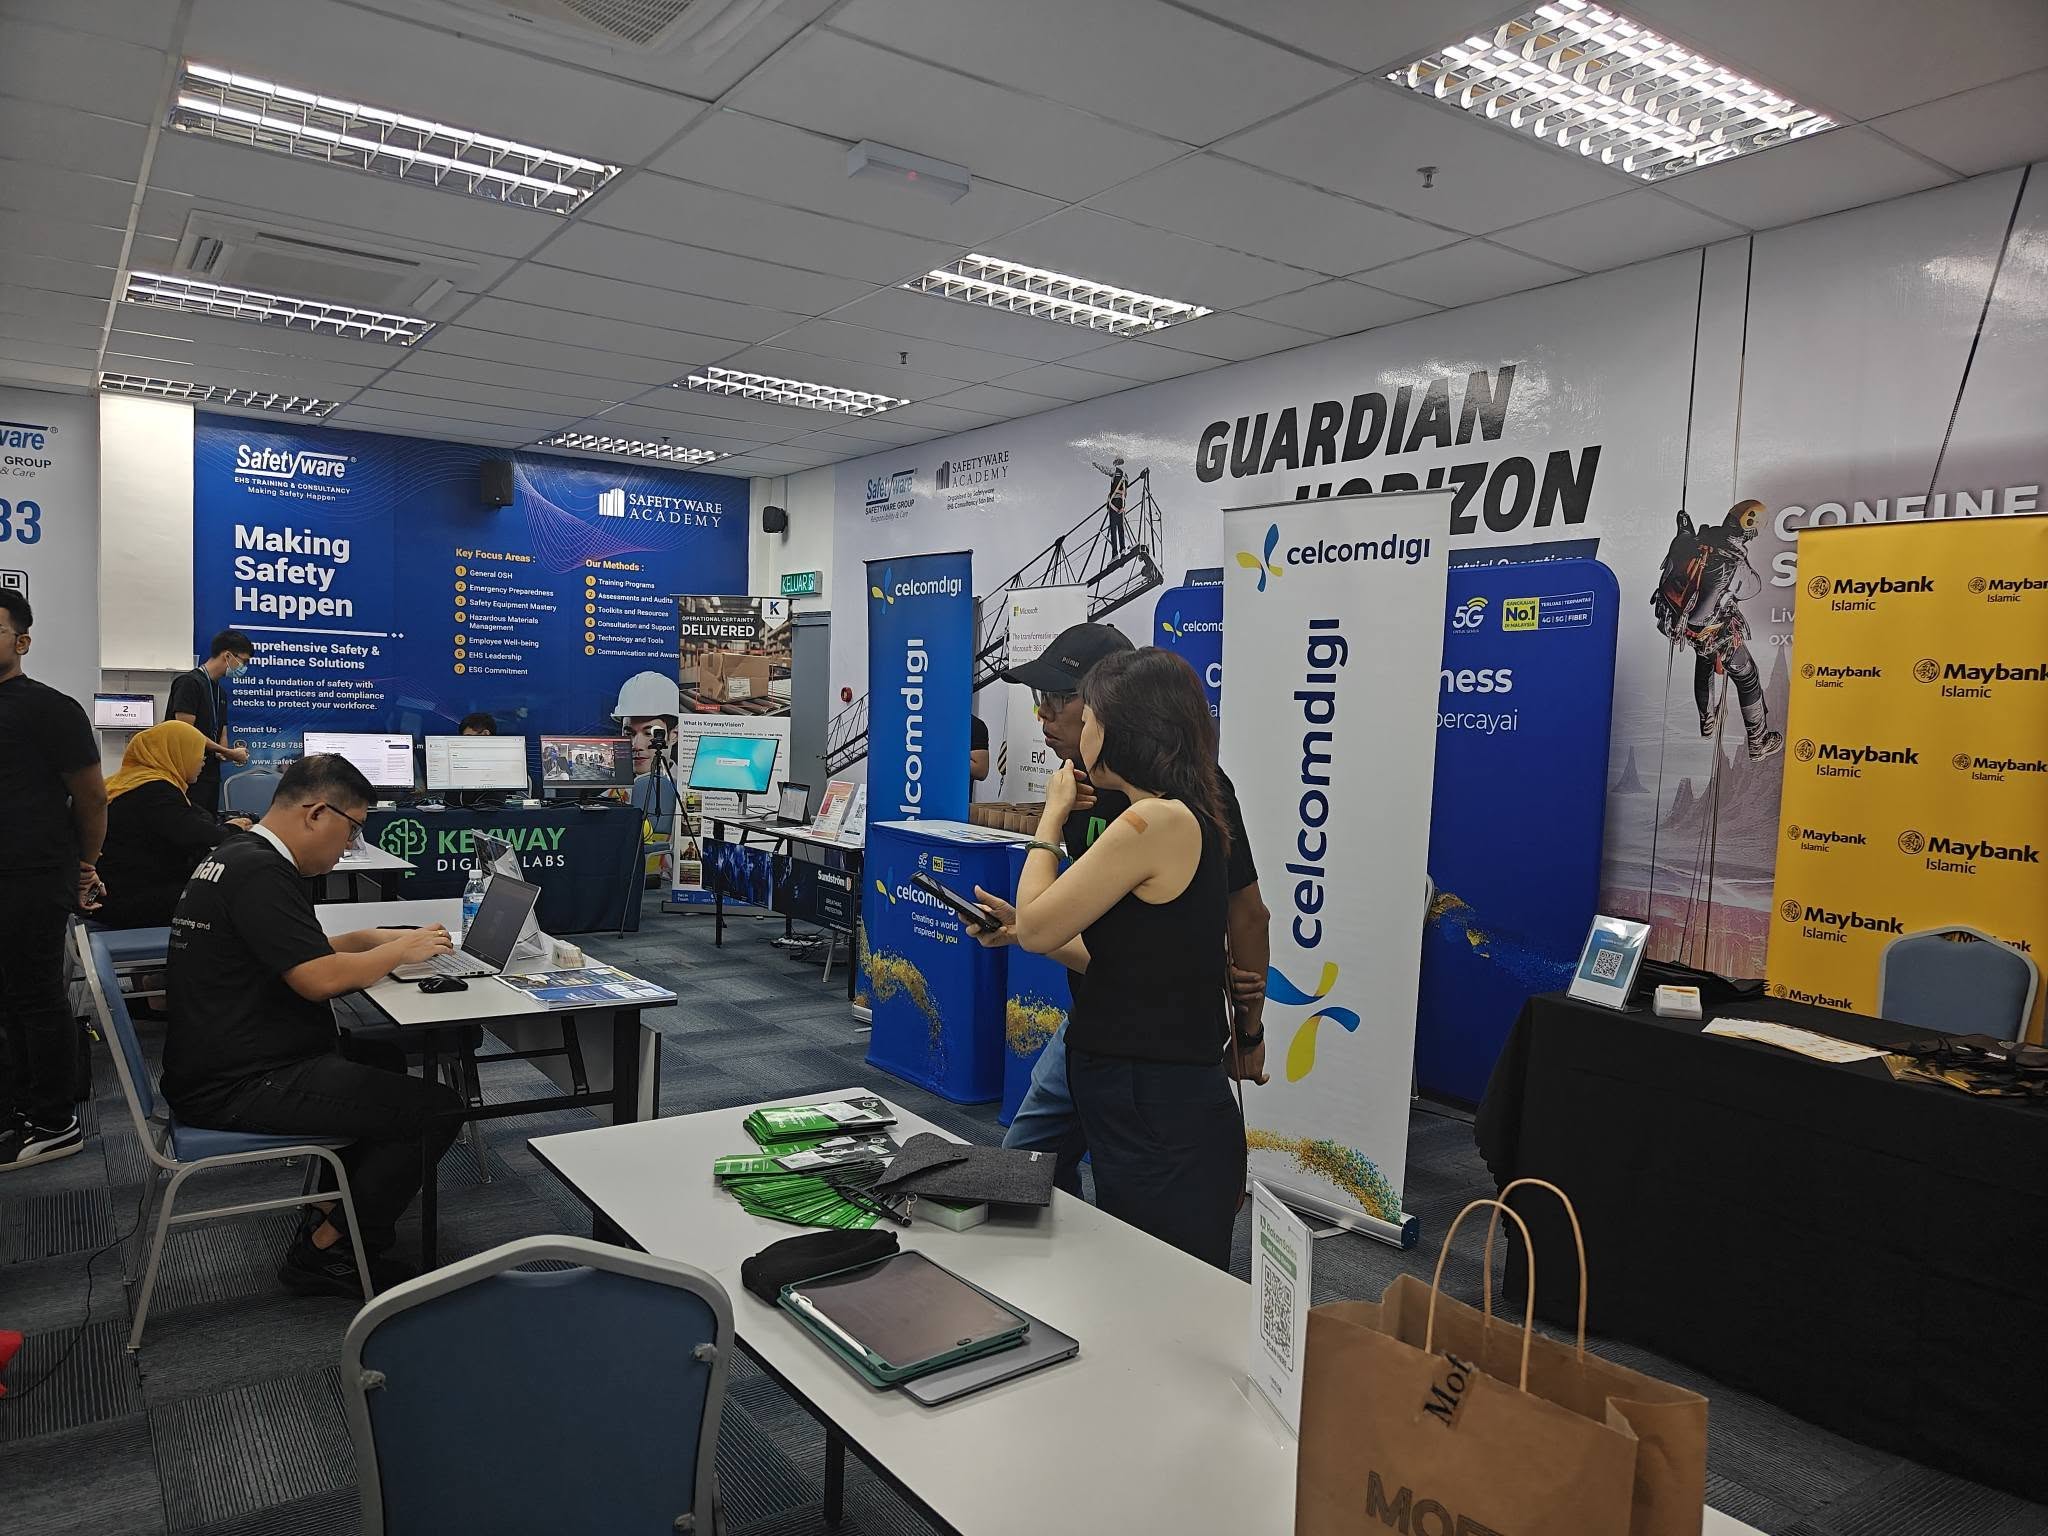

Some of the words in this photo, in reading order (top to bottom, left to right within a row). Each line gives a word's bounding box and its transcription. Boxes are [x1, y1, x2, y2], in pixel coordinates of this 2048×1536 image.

[1195, 365, 1517, 484] GUARDIAN
[4, 455, 52, 469] GROUP
[235, 444, 350, 479] Safetyware
[952, 450, 1009, 474] SAFETYWARE
[12, 467, 36, 478] Care
[952, 465, 1009, 489] ACADEMY
[248, 486, 277, 497] Making
[279, 489, 304, 500] Safety
[306, 492, 336, 502] Happen
[252, 478, 289, 488] TRAINING
[297, 483, 351, 495] CONSULTANCY
[629, 493, 723, 515] SAFETYWARE
[629, 508, 721, 528] ACADEMY
[235, 524, 350, 564] Making
[1286, 533, 1431, 568] celcomdigi
[455, 548, 474, 559] Key
[475, 550, 503, 561] Focus
[505, 552, 531, 563] Areas
[585, 559, 601, 568] Our
[603, 560, 640, 571] Methods
[234, 556, 336, 592] Safety
[469, 569, 496, 579] General
[497, 571, 513, 579] OSH
[598, 578, 624, 588] Training
[624, 580, 655, 589] Programs
[782, 573, 808, 592] KELUAR
[895, 575, 962, 598] celcomdigi
[1832, 575, 1935, 598] Maybank
[469, 584, 508, 595] Emergency
[508, 587, 554, 597] Preparedness
[598, 592, 640, 602] Assessments
[653, 596, 673, 604] Audits
[1987, 593, 2021, 603] Islamic
[235, 586, 353, 621] Happen
[469, 599, 491, 608] Safety
[492, 600, 529, 610] Equipment
[529, 603, 557, 612] Mastery
[769, 601, 780, 616] K
[1831, 599, 1877, 612] Islamic
[597, 606, 623, 615] Toolkits
[624, 608, 636, 616] and
[637, 609, 669, 617] Resources
[1452, 605, 1484, 629] 5G
[1505, 605, 1536, 622] No.1
[1541, 616, 1551, 624] 4G
[1568, 613, 1588, 621] FIBER
[469, 614, 507, 622] Hazardous
[507, 616, 539, 625] Materials
[469, 622, 514, 632] Management
[597, 620, 637, 629] Consultation
[651, 623, 675, 632] Support
[682, 624, 755, 637] DELIVERED
[469, 637, 502, 647] Employee
[503, 639, 540, 648] Well-being
[597, 634, 634, 644] Technology
[647, 637, 664, 645] Tools
[251, 640, 328, 653] mprehensive
[330, 643, 369, 658] Safety
[371, 646, 380, 656] &
[469, 651, 484, 659] EHS
[485, 652, 522, 662] Leadership
[597, 649, 647, 658] Communication
[647, 651, 659, 659] and
[249, 655, 306, 668] mpliance
[308, 657, 365, 670] Solutions
[484, 667, 528, 675] Commitment
[1816, 665, 1882, 680] Maybank
[1943, 663, 2048, 684] Maybank
[232, 676, 256, 685] Build
[266, 677, 314, 687] foundation
[316, 678, 325, 687] of
[327, 679, 354, 690] safety
[355, 681, 374, 689] with
[1815, 679, 1844, 688] Islamic
[232, 688, 274, 697] essential
[275, 689, 316, 698] practices
[318, 690, 334, 698] and
[336, 690, 385, 700] compliance
[1941, 685, 1992, 699] Islamic
[122, 705, 129, 713] 2
[232, 698, 265, 707] checks
[278, 699, 310, 710] protect
[311, 701, 331, 710] your
[332, 700, 378, 711] workforce.
[232, 725, 265, 734] Contact
[266, 726, 277, 734] Us
[251, 741, 287, 750] 012-498
[1818, 743, 1919, 766] Maybank
[1816, 764, 1862, 778] Islamic
[1972, 757, 2048, 774] Maybank
[1284, 618, 1349, 950] celcomdigi
[1971, 771, 2005, 782] Islamic
[1801, 828, 1867, 846] Maybank
[1800, 842, 1830, 853] Islamic
[1928, 836, 2040, 864] Maybank
[437, 857, 480, 872] DIGI
[523, 855, 565, 868] LABS
[1926, 857, 1977, 875] Islamic
[911, 911, 934, 927] Creating
[940, 922, 959, 931] world
[1804, 906, 1905, 935] Maybank
[913, 923, 936, 938] inspired
[936, 930, 945, 942] by
[945, 934, 958, 944] you
[1802, 925, 1848, 943] Islamic
[1788, 989, 1853, 1010] Maybank
